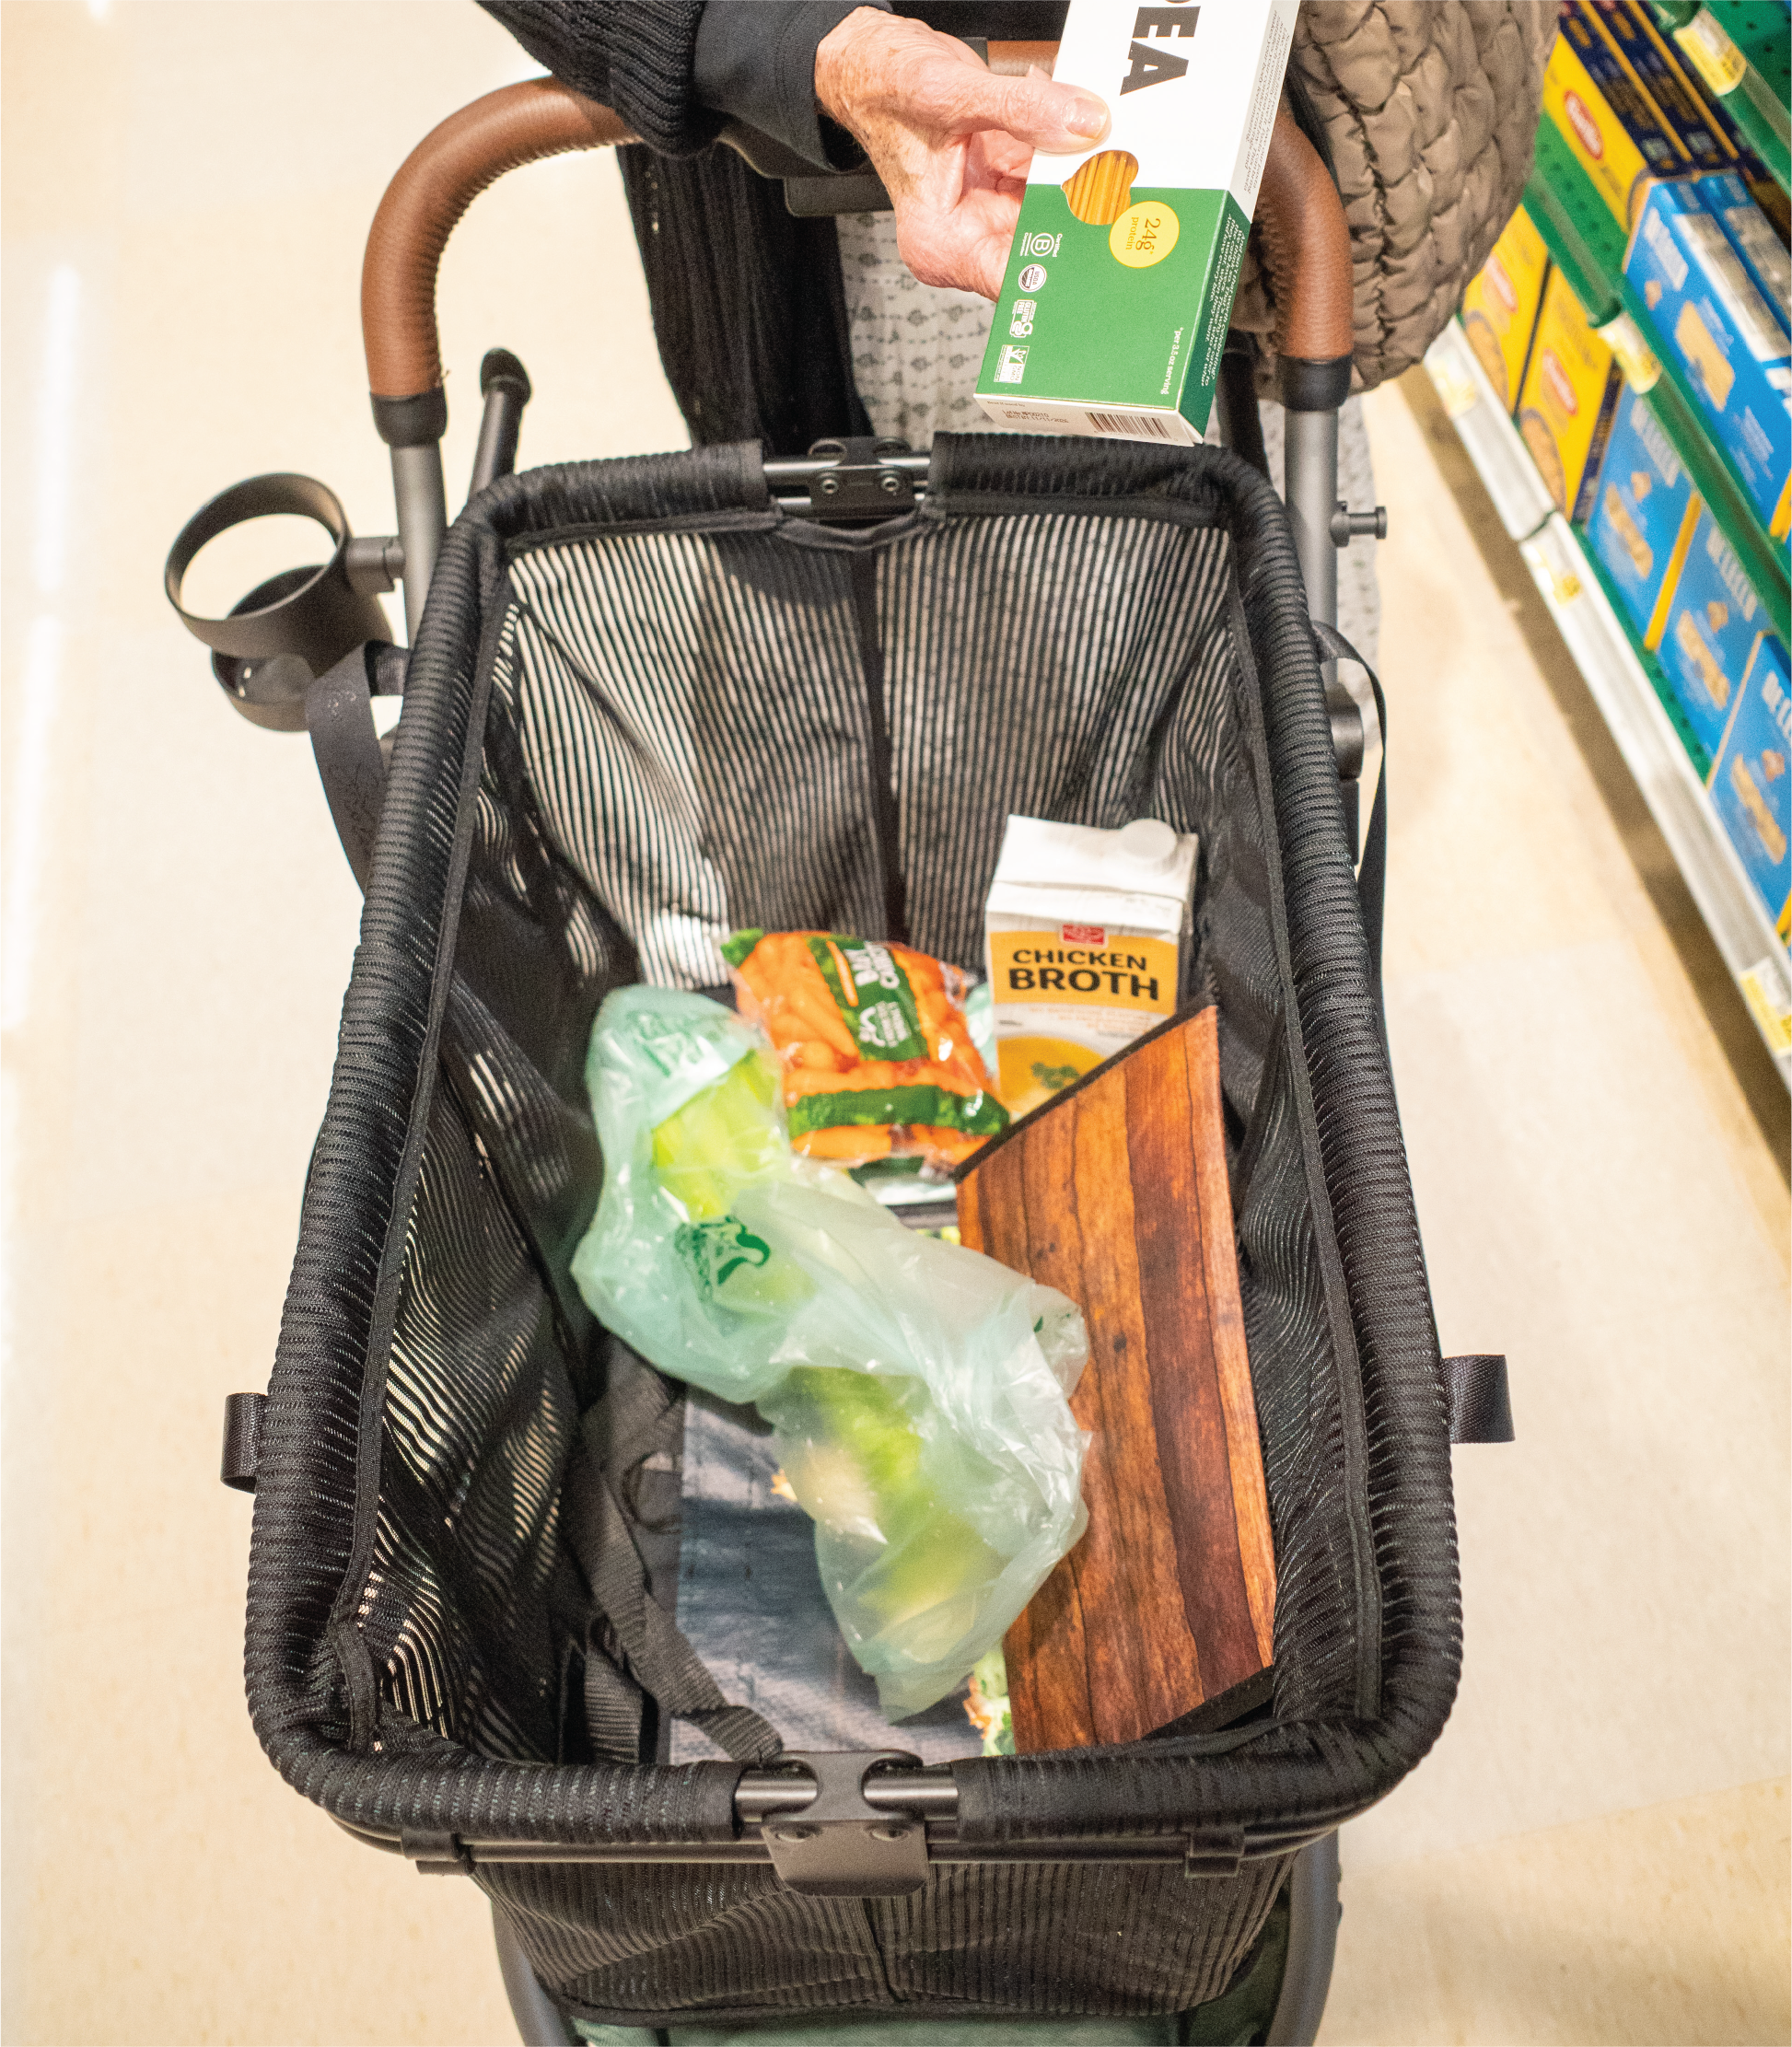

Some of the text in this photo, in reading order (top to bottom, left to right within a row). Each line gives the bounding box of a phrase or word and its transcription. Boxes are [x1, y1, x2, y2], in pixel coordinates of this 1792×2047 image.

[1120, 0, 1201, 96] EA
[1052, 233, 1063, 257] Certified
[1125, 217, 1139, 250] protein
[1016, 302, 1025, 314] FREE
[1021, 302, 1031, 322] GLUTEN
[1223, 295, 1231, 322] worth
[1168, 355, 1175, 365] oz
[1161, 366, 1173, 394] serving
[1205, 375, 1209, 385] to
[1013, 949, 1146, 971] CHICKEN
[1009, 968, 1158, 1000] BROTH
